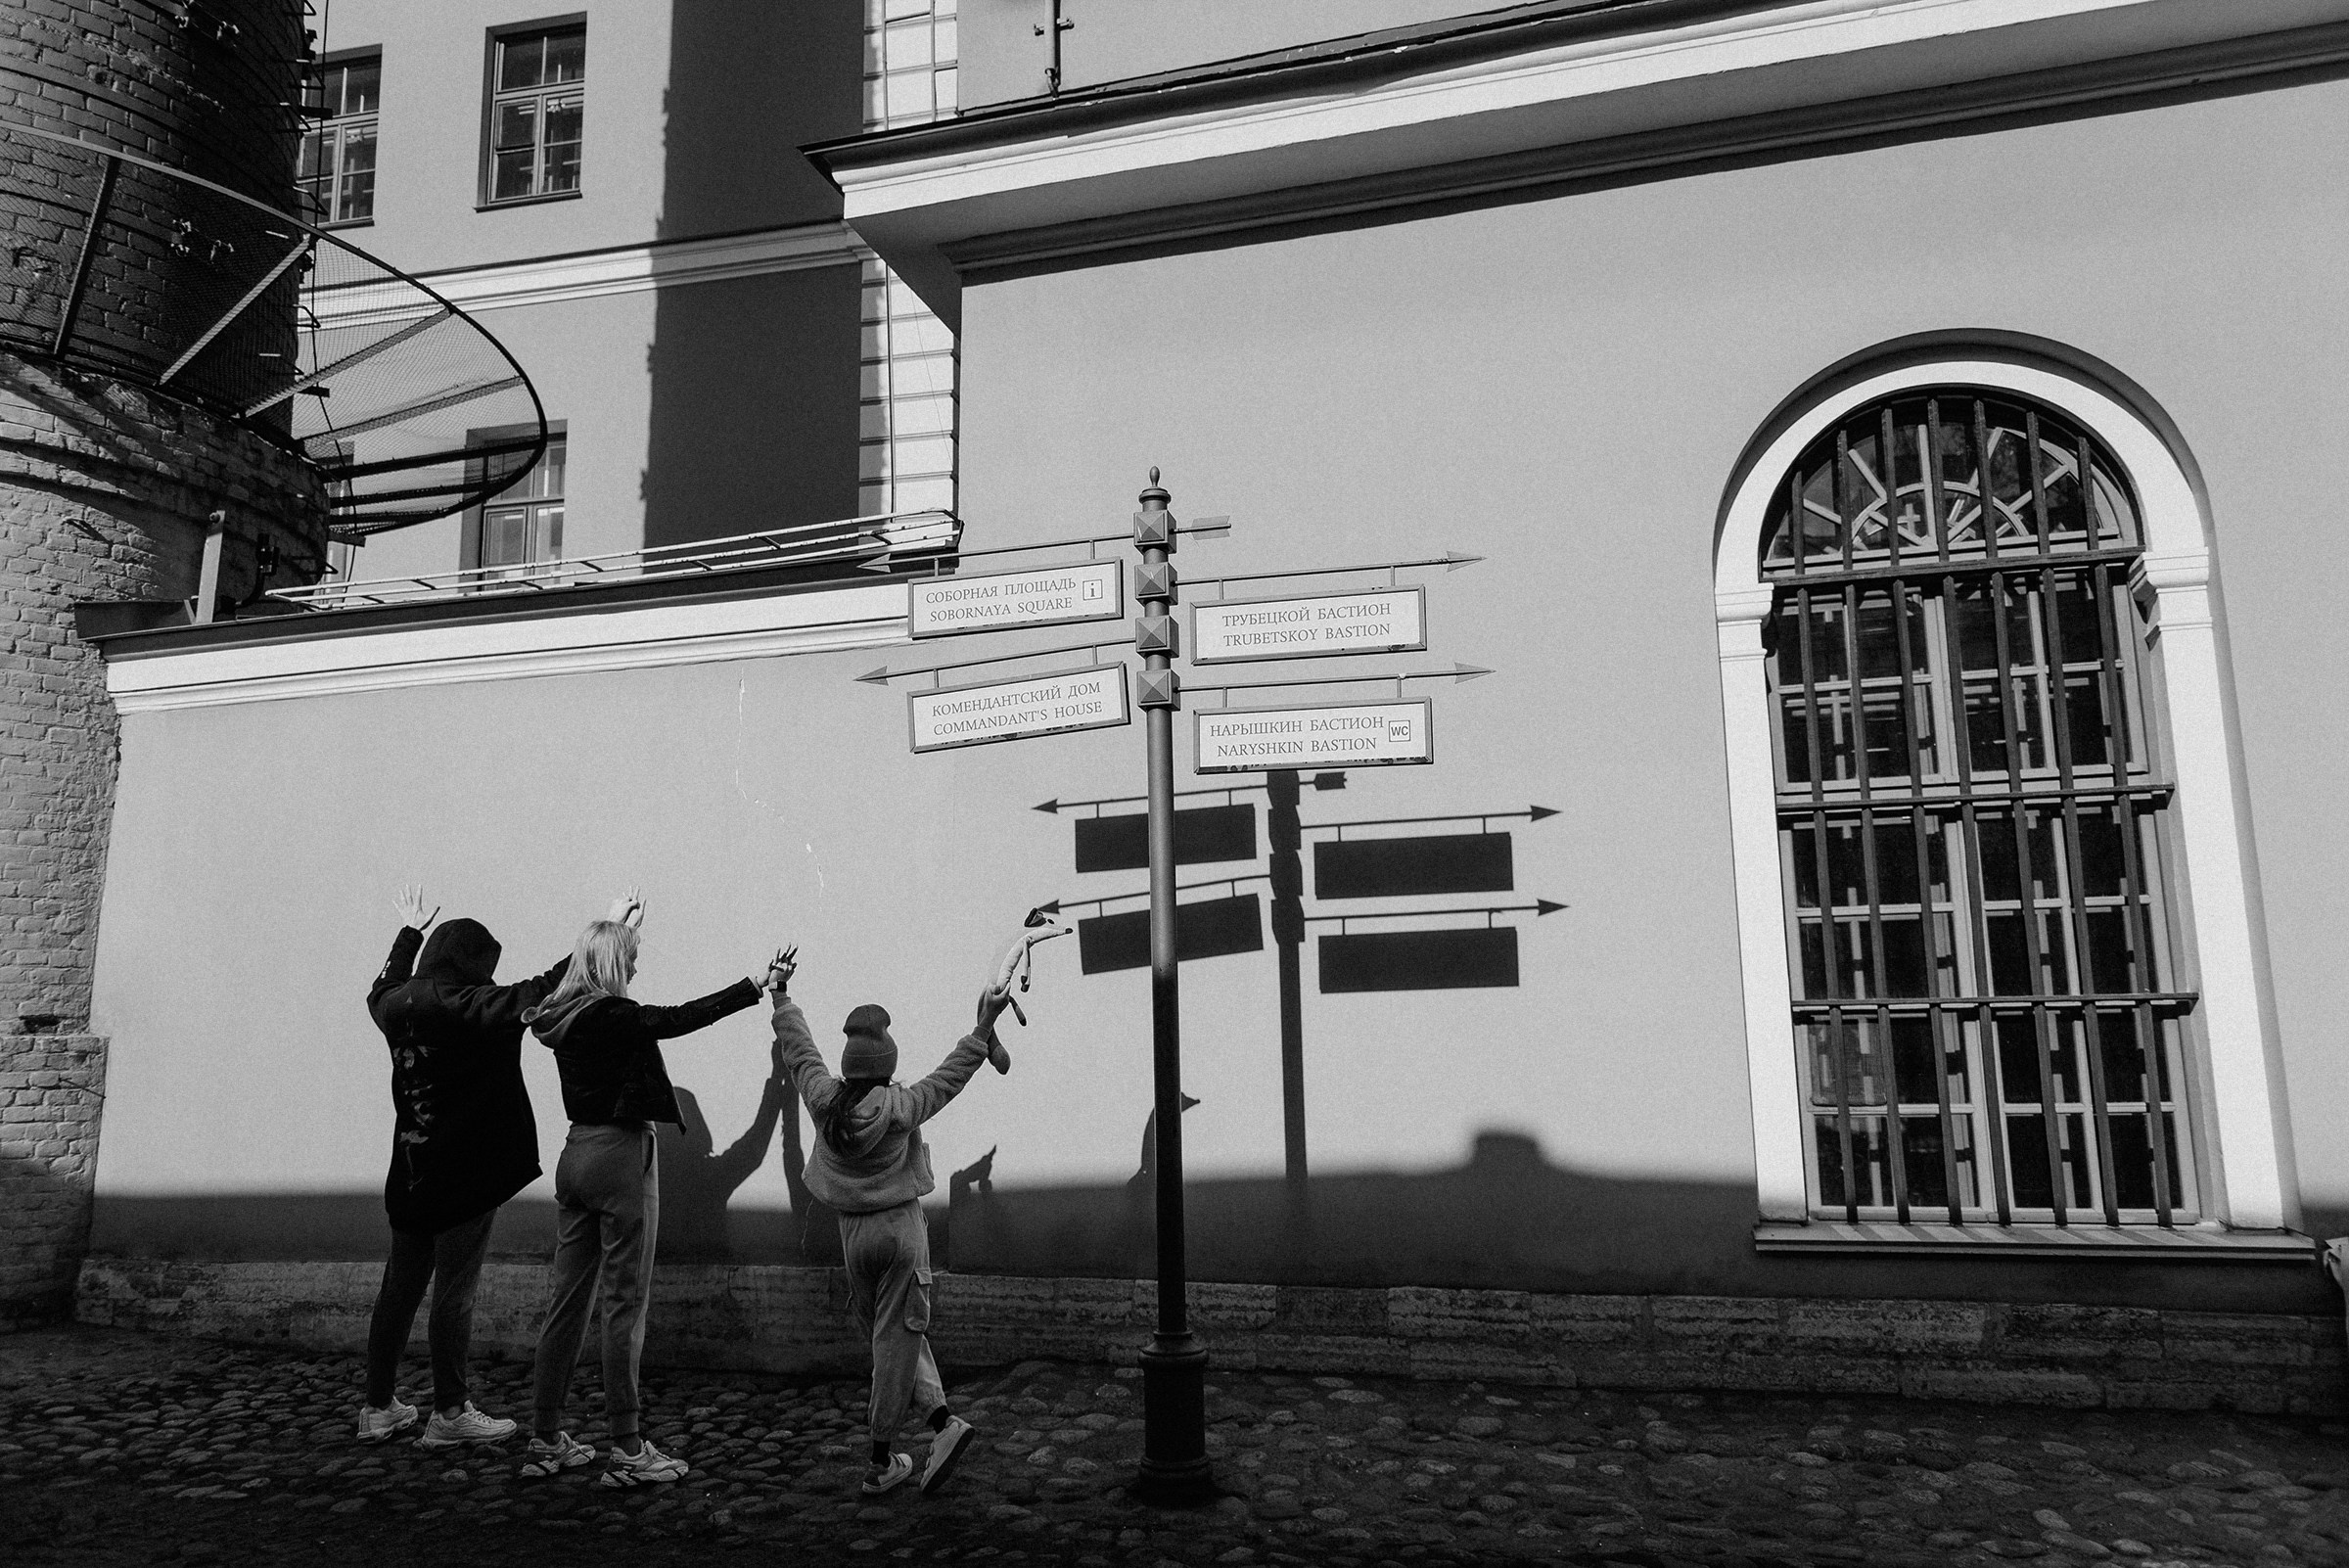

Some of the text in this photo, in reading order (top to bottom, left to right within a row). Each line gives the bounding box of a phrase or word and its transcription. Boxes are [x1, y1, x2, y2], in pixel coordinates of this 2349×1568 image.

[926, 577, 1077, 604] СОБОРНАЯ ПЛОЩАДЬ
[930, 597, 1073, 623] SOBORNAYA SQUARE
[1222, 603, 1392, 626] ТРУБЕЦКОЙ БАСТИОН
[1223, 623, 1391, 647] TRUBETSKOY BASTION
[932, 681, 1101, 717] КОМЕНДАНТСКИЙ ДОМ
[934, 701, 1103, 736] COMMANDANT'S HOUSE
[1210, 715, 1384, 737] НАРЫШКИН БАСТИОН
[1390, 724, 1409, 736] WC
[1218, 737, 1377, 758] NARYSHKIN BASTION
